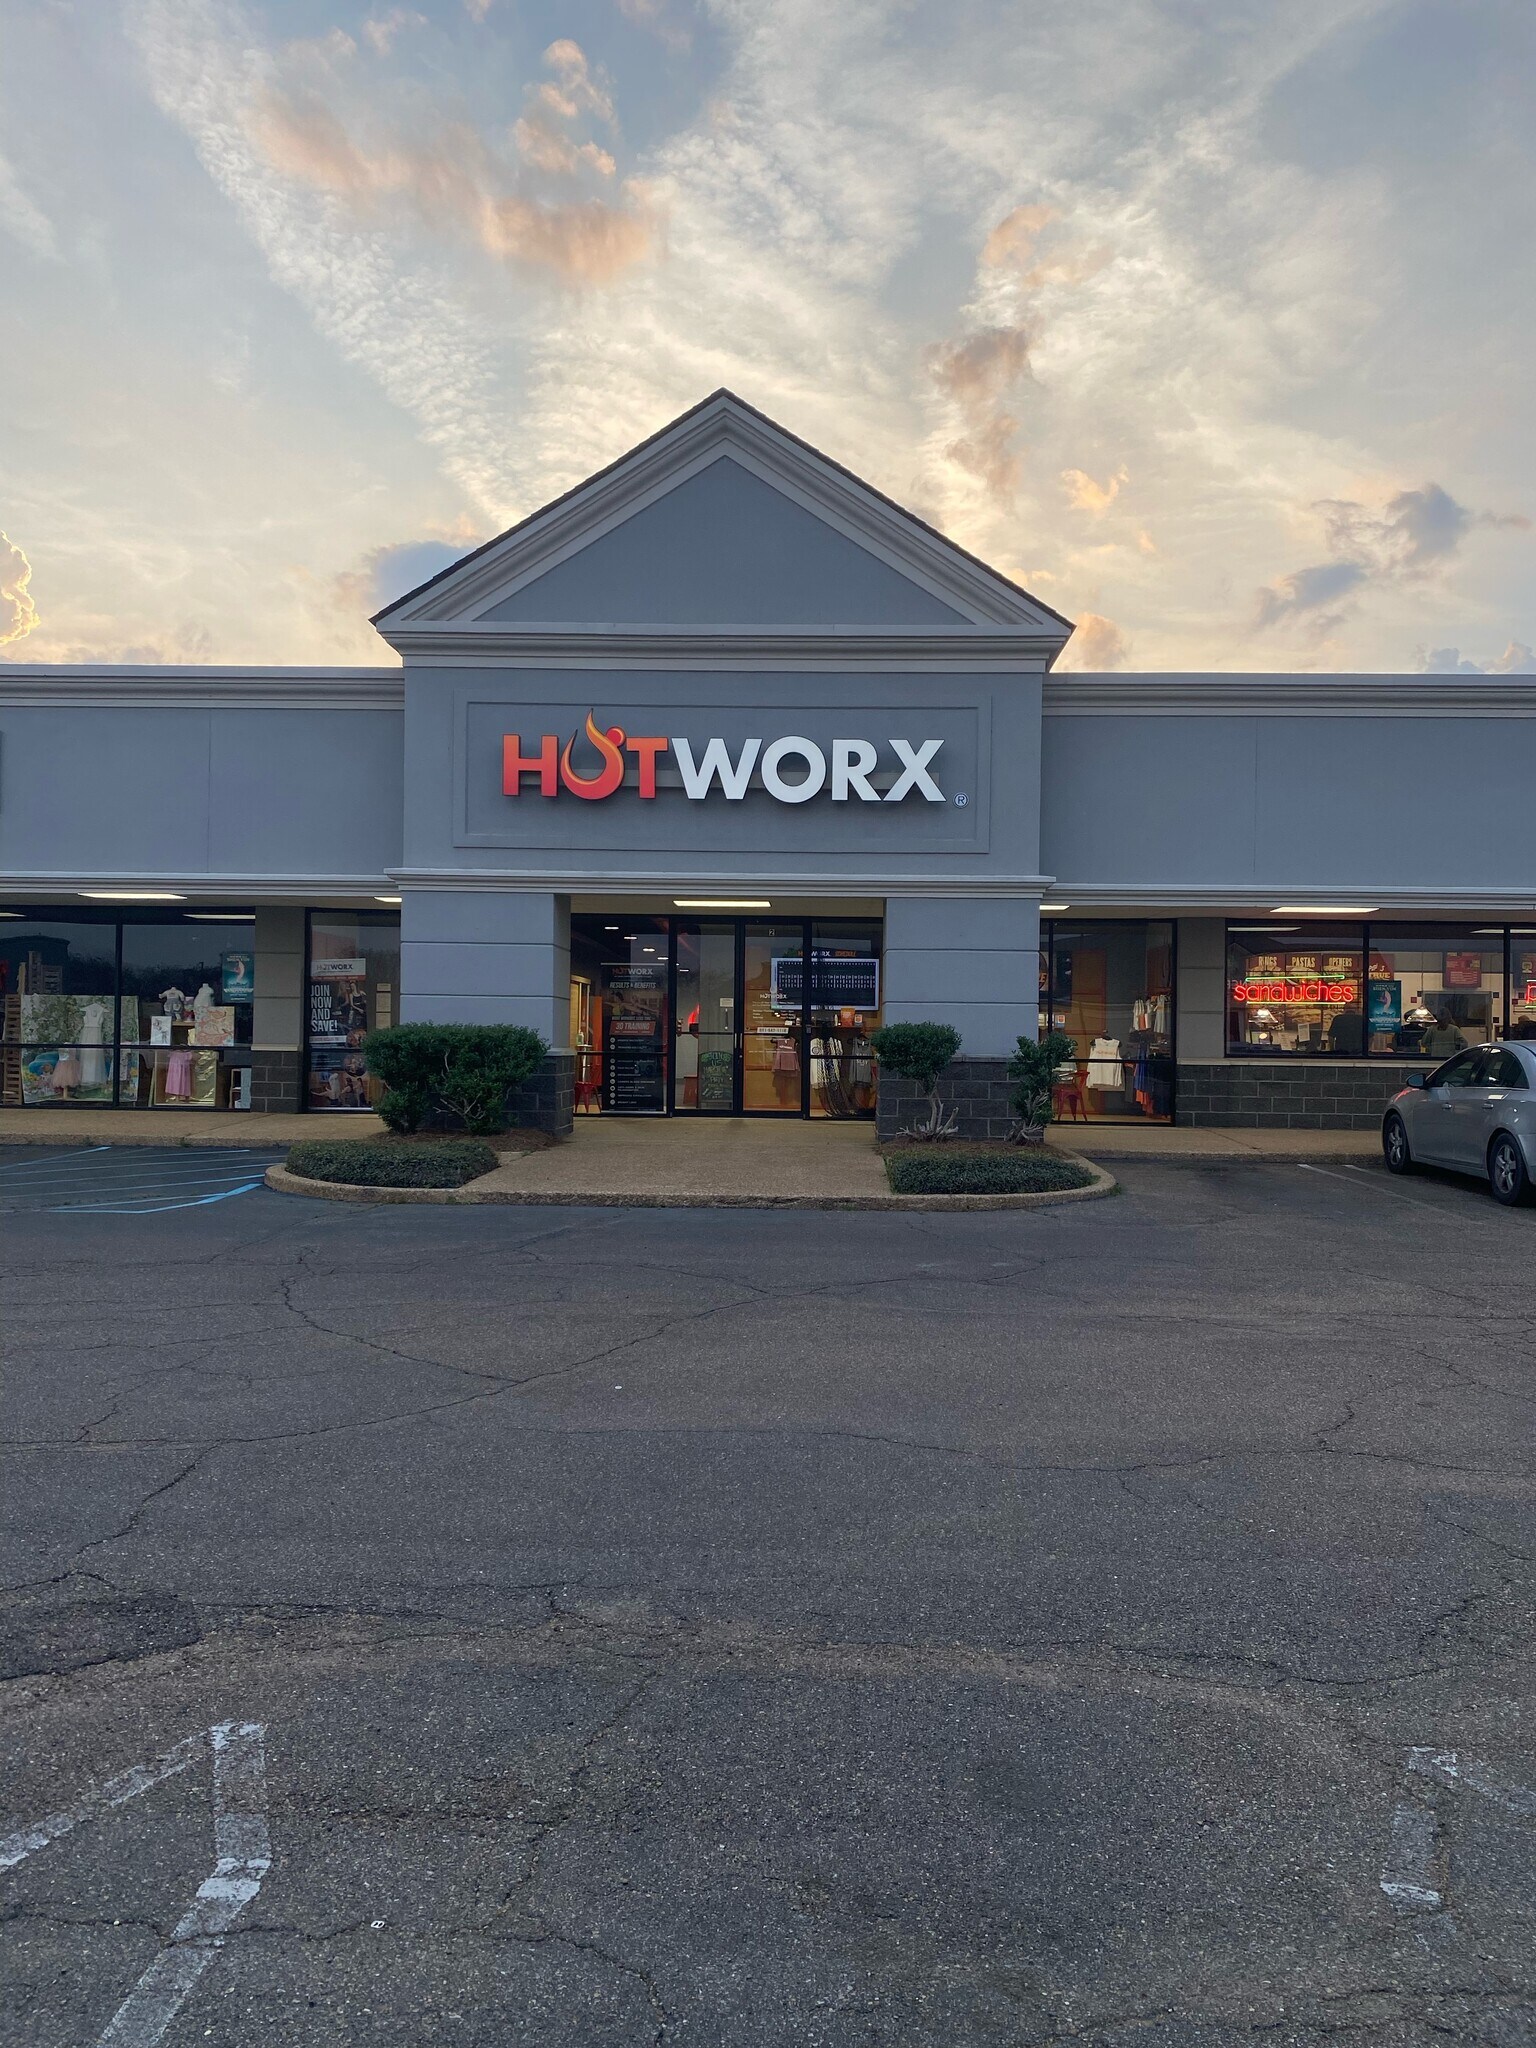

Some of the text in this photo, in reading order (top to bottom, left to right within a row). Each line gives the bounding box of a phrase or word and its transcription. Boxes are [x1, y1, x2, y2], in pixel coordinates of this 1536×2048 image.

[502, 708, 947, 803] HOTWORX
[1291, 957, 1316, 968] PASTAS
[311, 985, 330, 997] JOIN
[1233, 980, 1354, 1002] sandwiches
[311, 997, 332, 1009] NOW
[311, 1009, 331, 1020] AND
[311, 1020, 338, 1032] SAVE!
